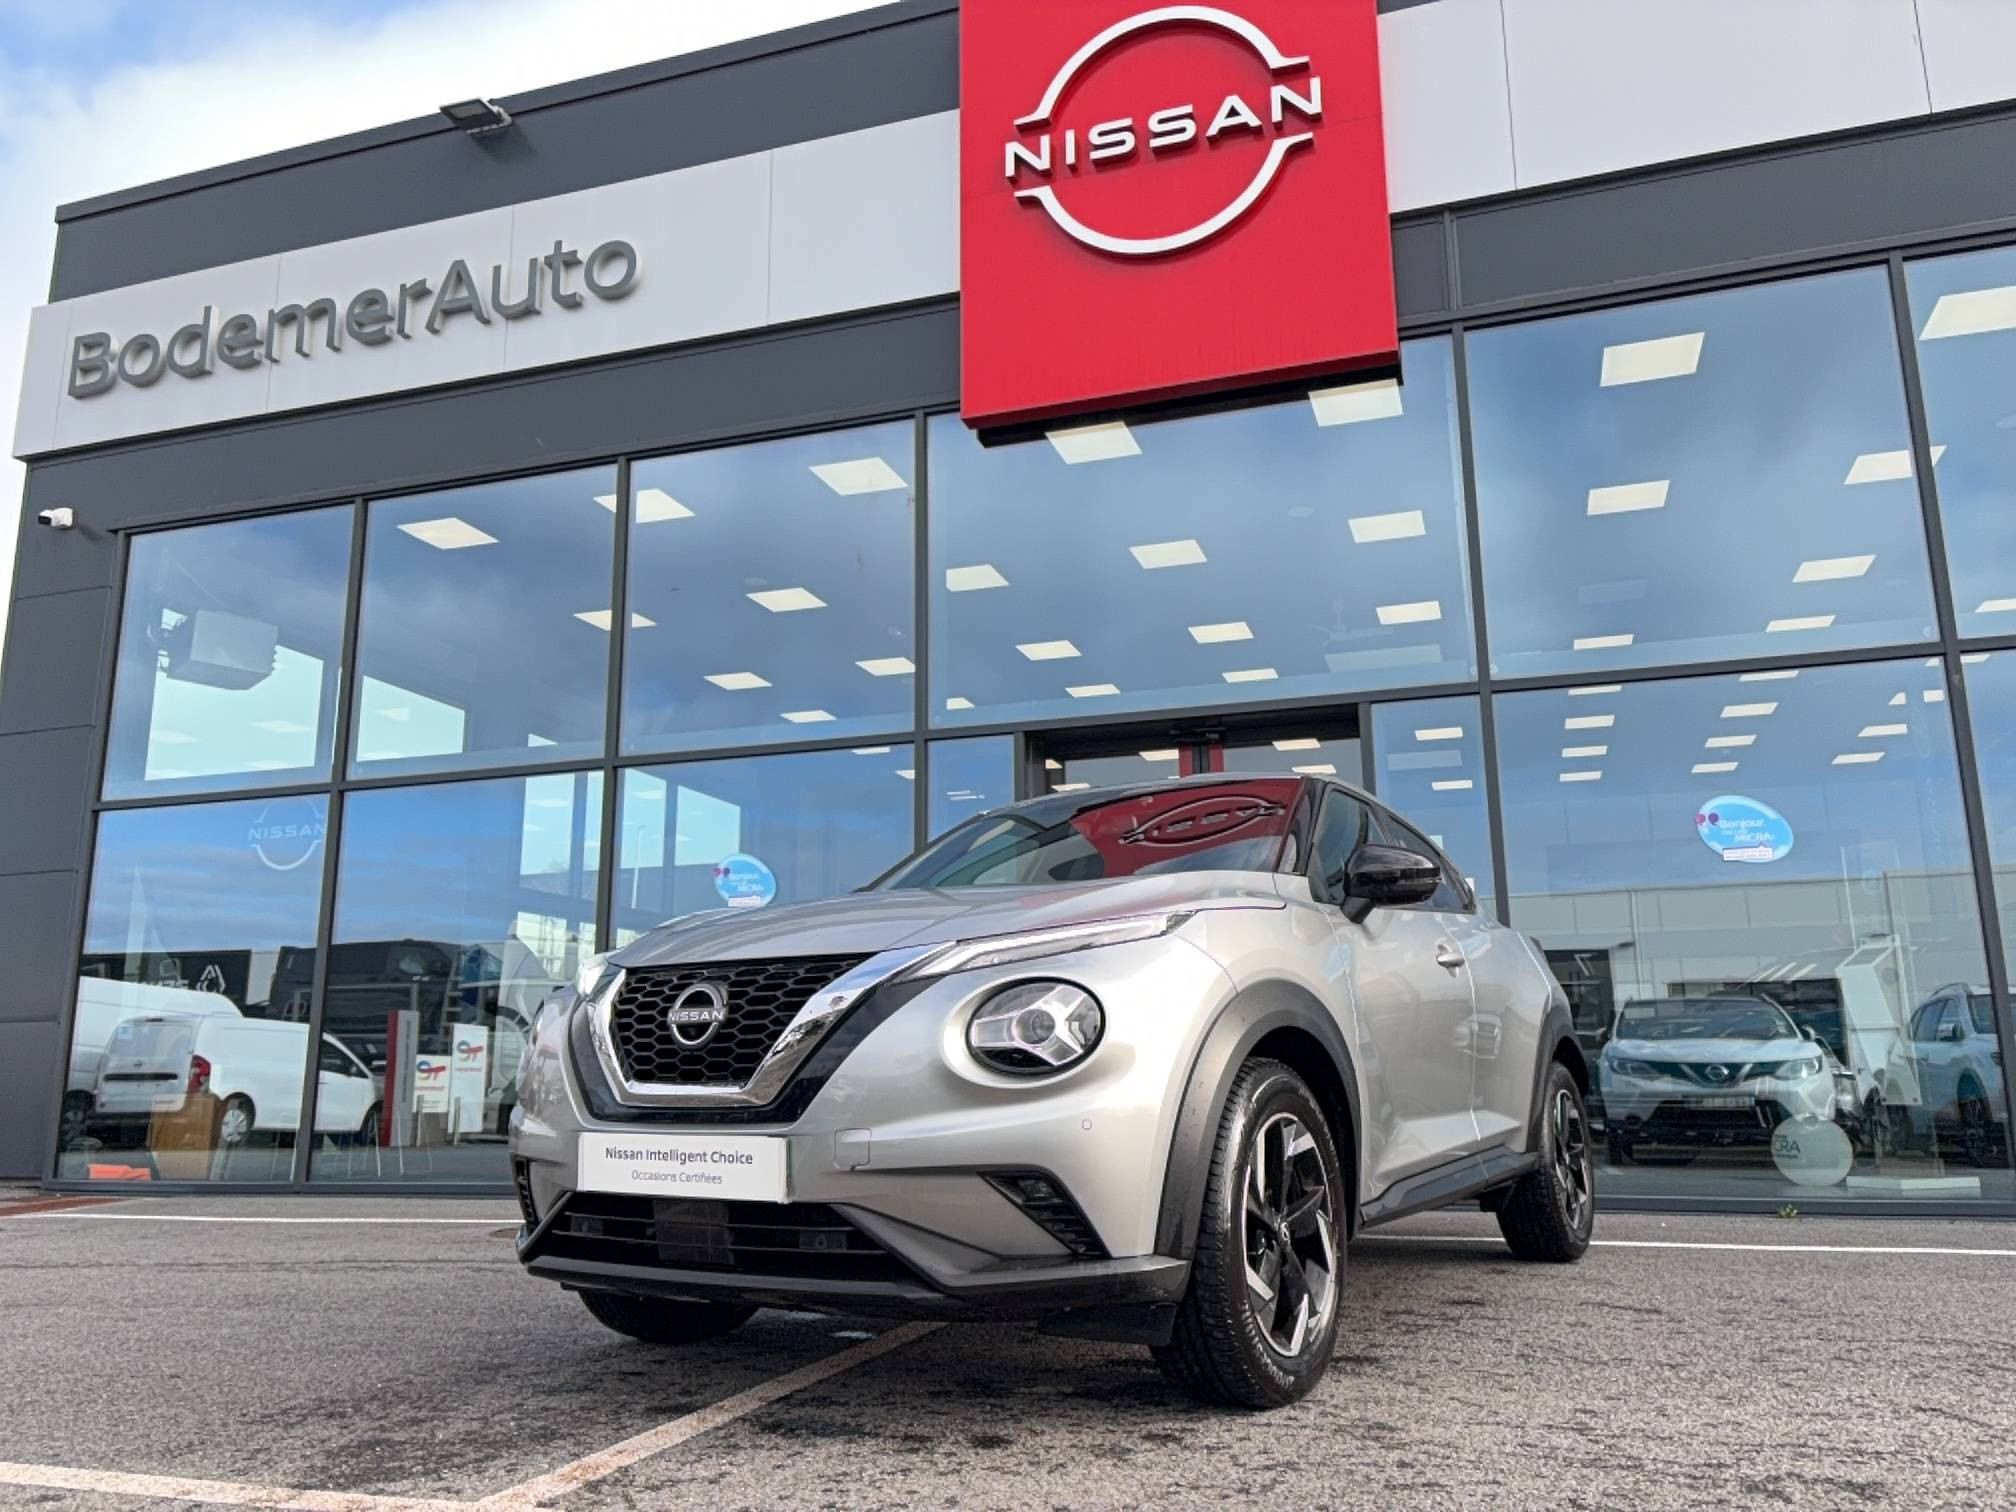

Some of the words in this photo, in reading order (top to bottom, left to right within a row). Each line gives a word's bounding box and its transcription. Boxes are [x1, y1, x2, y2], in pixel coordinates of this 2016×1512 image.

[1004, 76, 1322, 182] NISSAN
[67, 239, 639, 400] BodemerAuto
[248, 823, 326, 840] NISSAN
[669, 1010, 723, 1022] NISSAN
[605, 1146, 643, 1161] Nissan
[646, 1148, 707, 1165] Intelligent
[710, 1150, 753, 1165] Choice
[631, 1169, 677, 1182] Occasions
